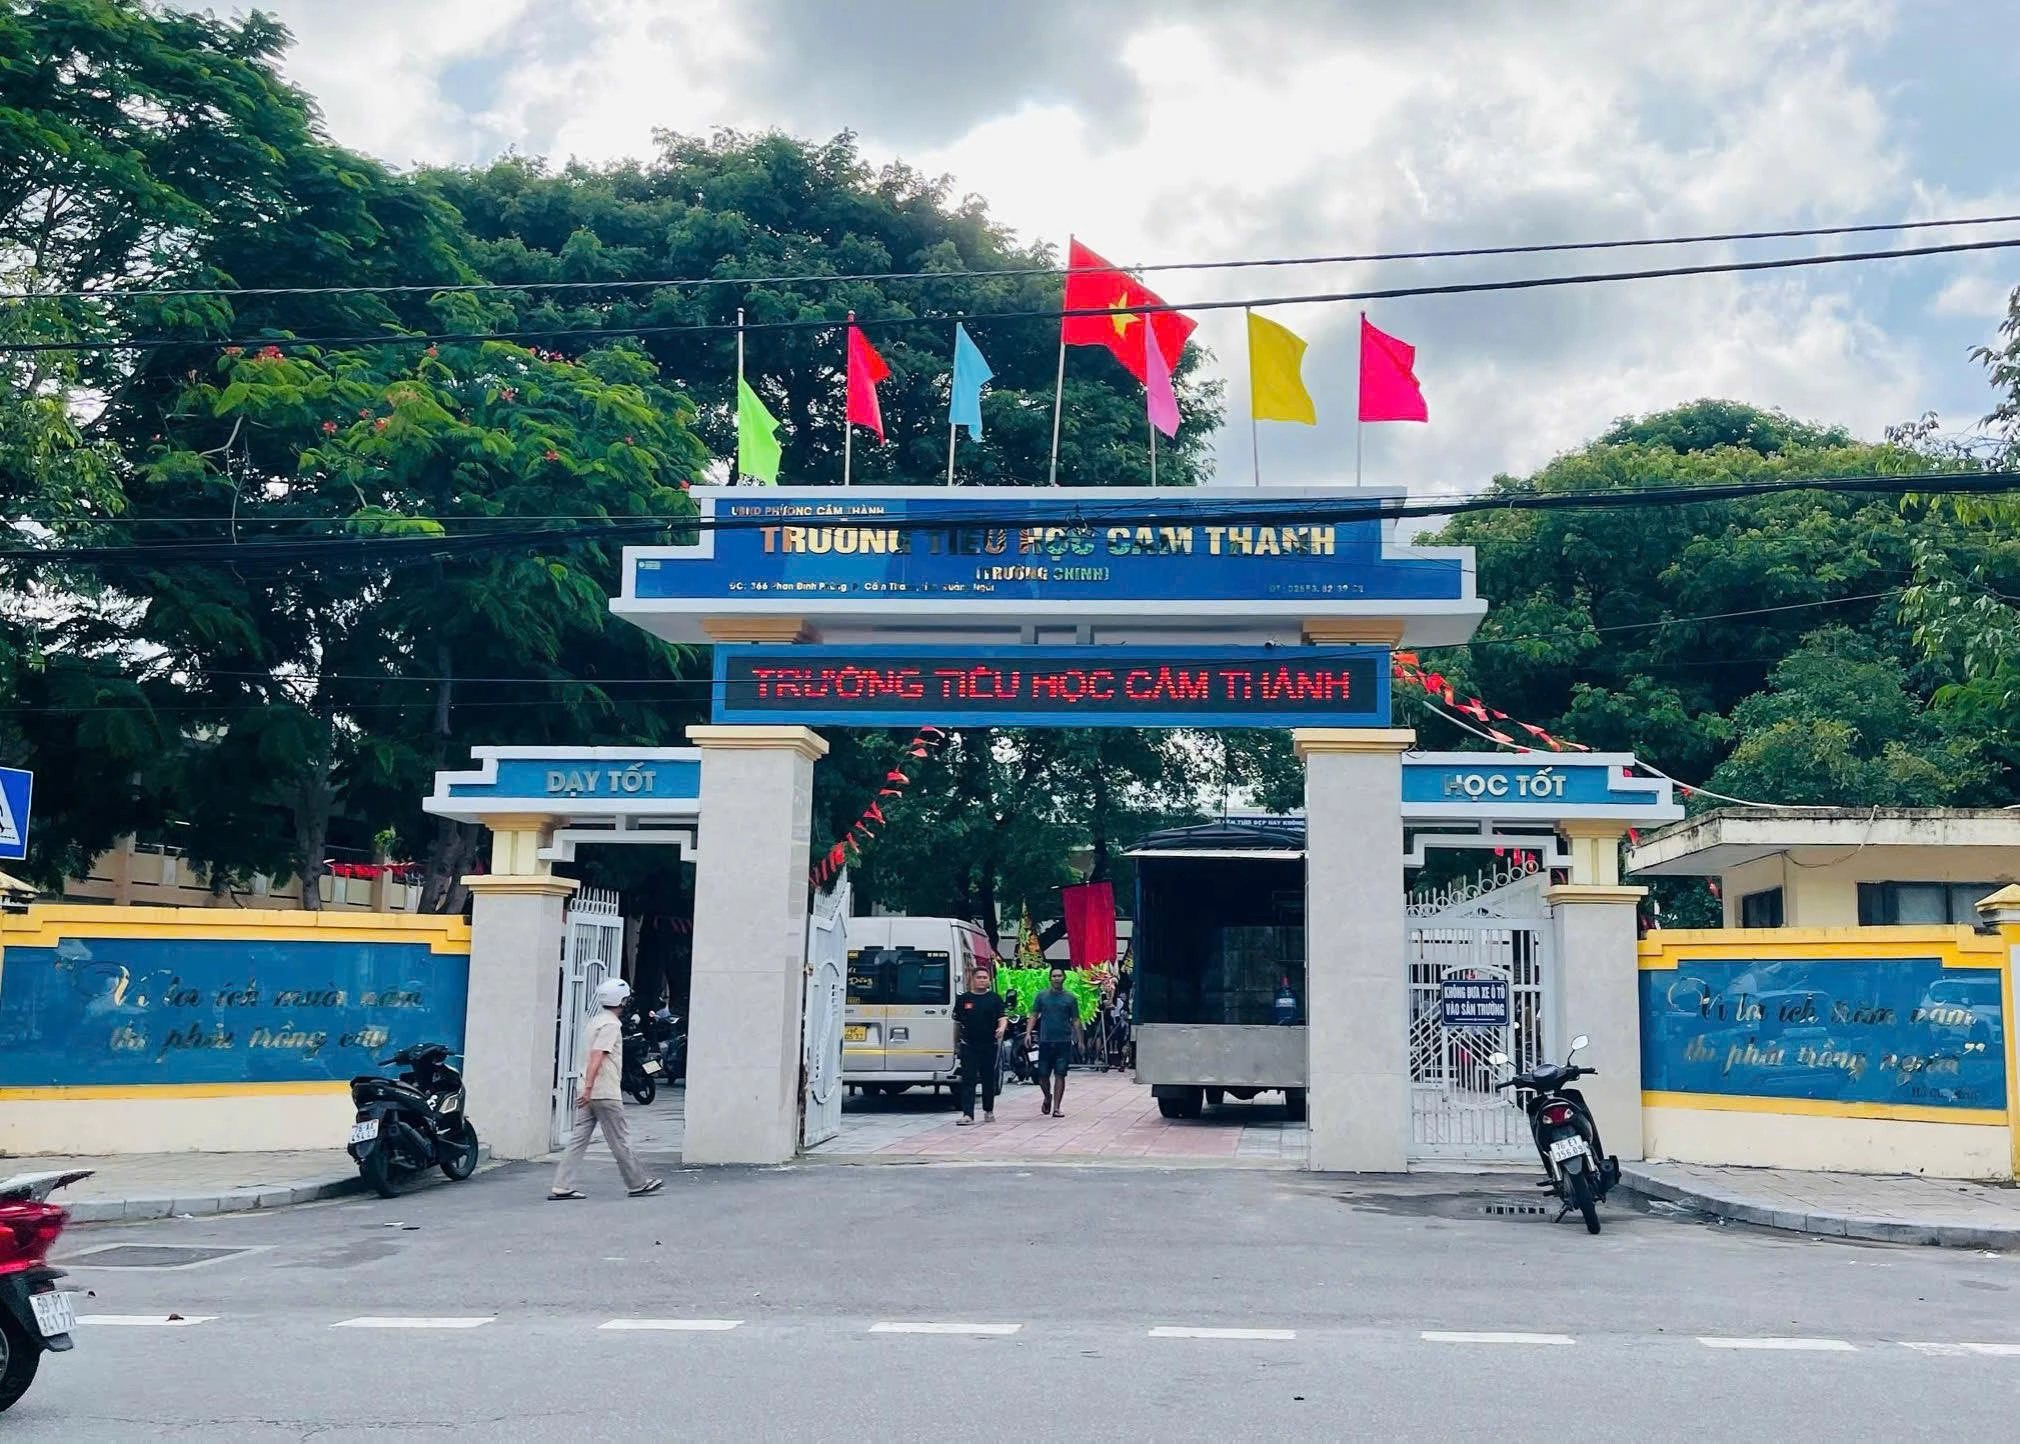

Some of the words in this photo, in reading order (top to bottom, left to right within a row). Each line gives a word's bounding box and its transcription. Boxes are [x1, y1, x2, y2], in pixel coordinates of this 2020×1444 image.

[1018, 526, 1095, 562] HỌC
[752, 667, 923, 697] TRƯỜNG
[1032, 670, 1114, 701] HỌC
[1126, 667, 1208, 699] CẨM
[1219, 666, 1349, 698] THÀNH
[547, 770, 600, 797] DẠY
[608, 762, 656, 792] TỐT
[1444, 774, 1509, 801] HỌC
[1516, 767, 1566, 797] TỐT
[1444, 984, 1466, 999] KHÔNG
[1467, 985, 1480, 999] ĐƯA
[1481, 986, 1490, 999] XE
[1491, 984, 1496, 999] Ô
[1497, 984, 1506, 999] TÔ
[1445, 1001, 1460, 1016] VÀO
[1461, 1001, 1475, 1016] SÂN
[1477, 1001, 1505, 1016] TRƯỜNG
